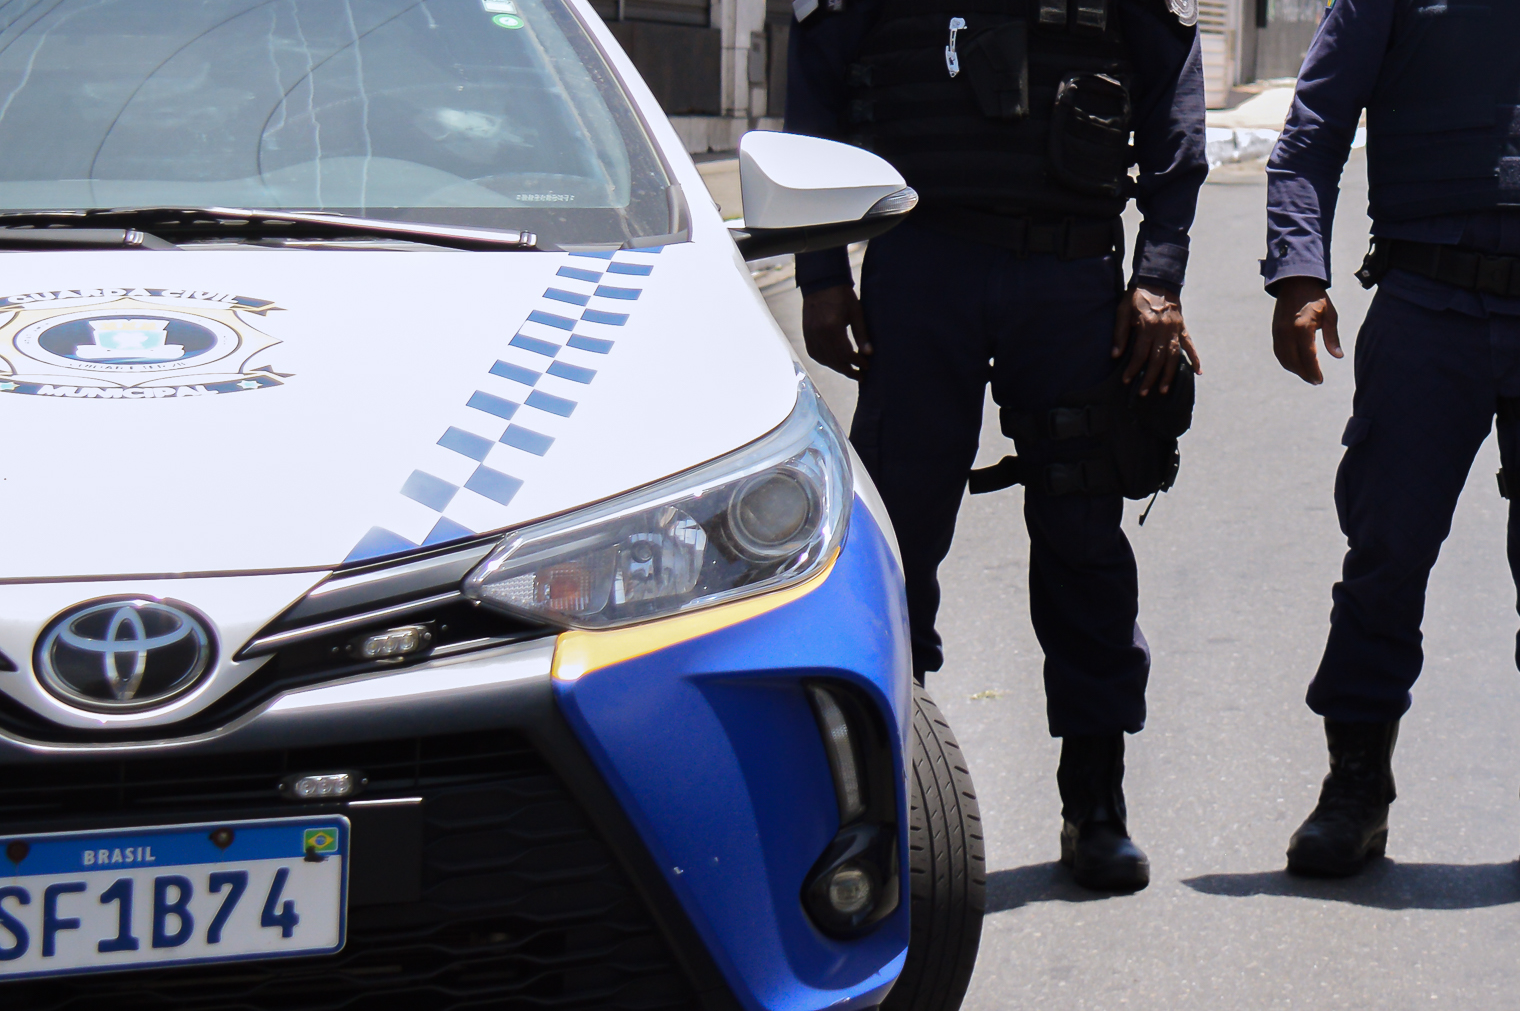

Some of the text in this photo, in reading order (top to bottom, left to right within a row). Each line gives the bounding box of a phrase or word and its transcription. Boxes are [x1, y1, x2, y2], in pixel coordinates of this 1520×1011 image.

[8, 288, 239, 304] GUARDA CIVIL
[37, 384, 220, 399] MUNICIPAL
[83, 845, 157, 867] BRASIL
[0, 866, 301, 962] SF1B74
